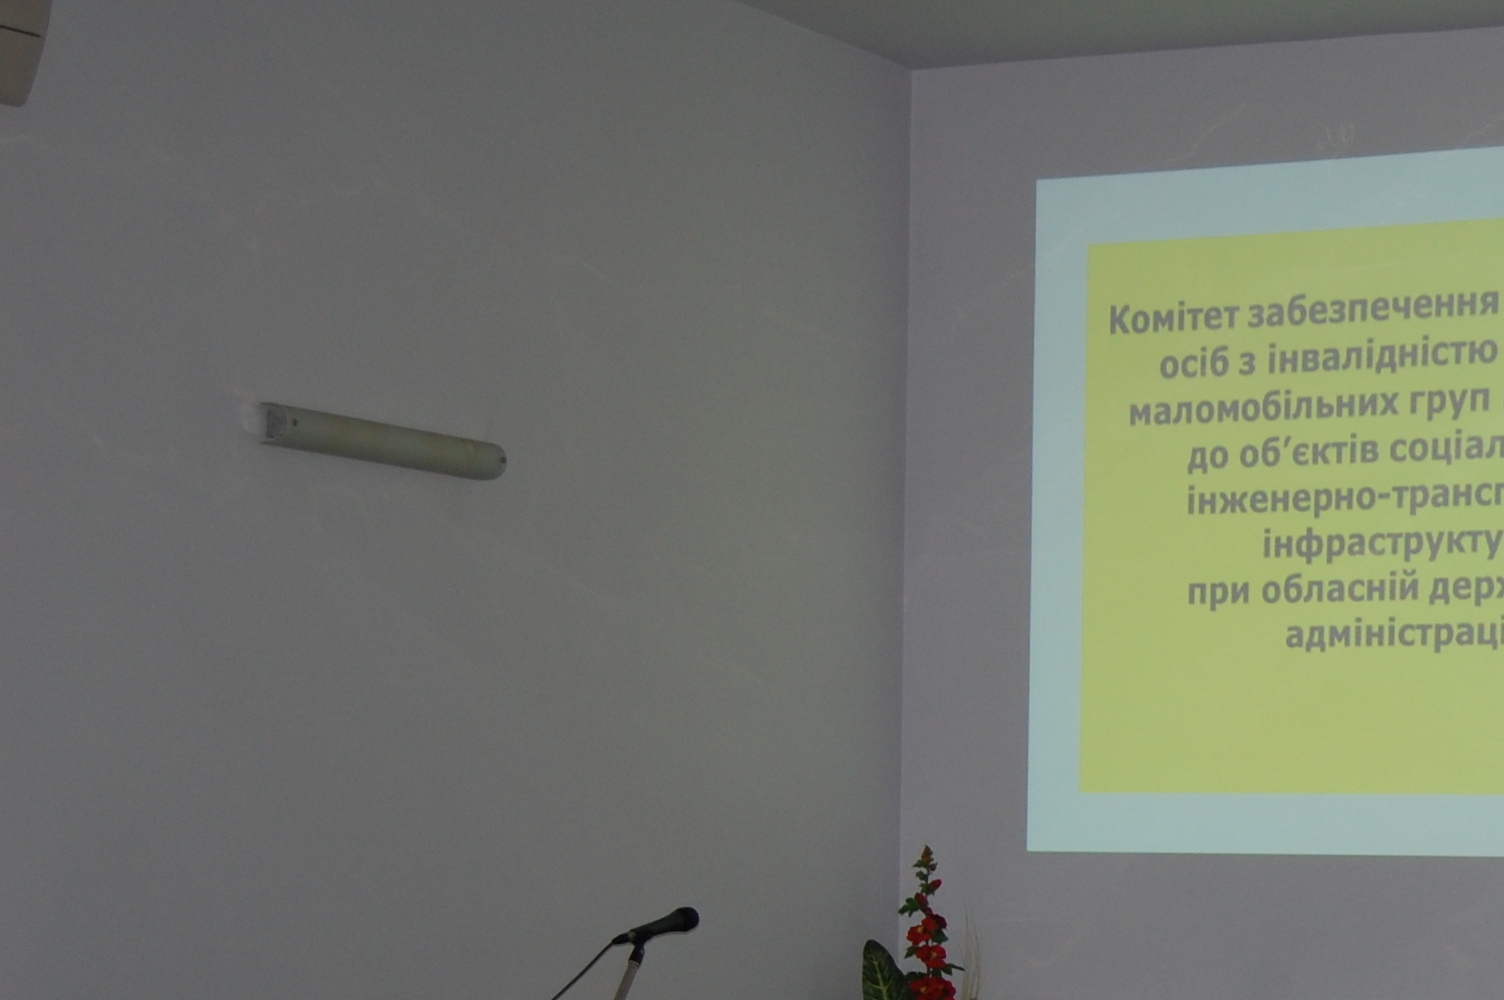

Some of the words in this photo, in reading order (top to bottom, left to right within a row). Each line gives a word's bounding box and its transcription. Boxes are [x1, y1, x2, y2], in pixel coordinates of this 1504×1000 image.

[1109, 300, 1241, 336] Комітет
[1247, 290, 1500, 328] забезпечення
[1160, 346, 1230, 380] осіб
[1239, 351, 1256, 376] з
[1269, 335, 1499, 374] інвалідністю
[1129, 390, 1399, 427] маломобільних
[1410, 388, 1490, 422] груп
[1187, 446, 1229, 475] до
[1188, 582, 1250, 613] при
[1261, 569, 1419, 605] обласній
